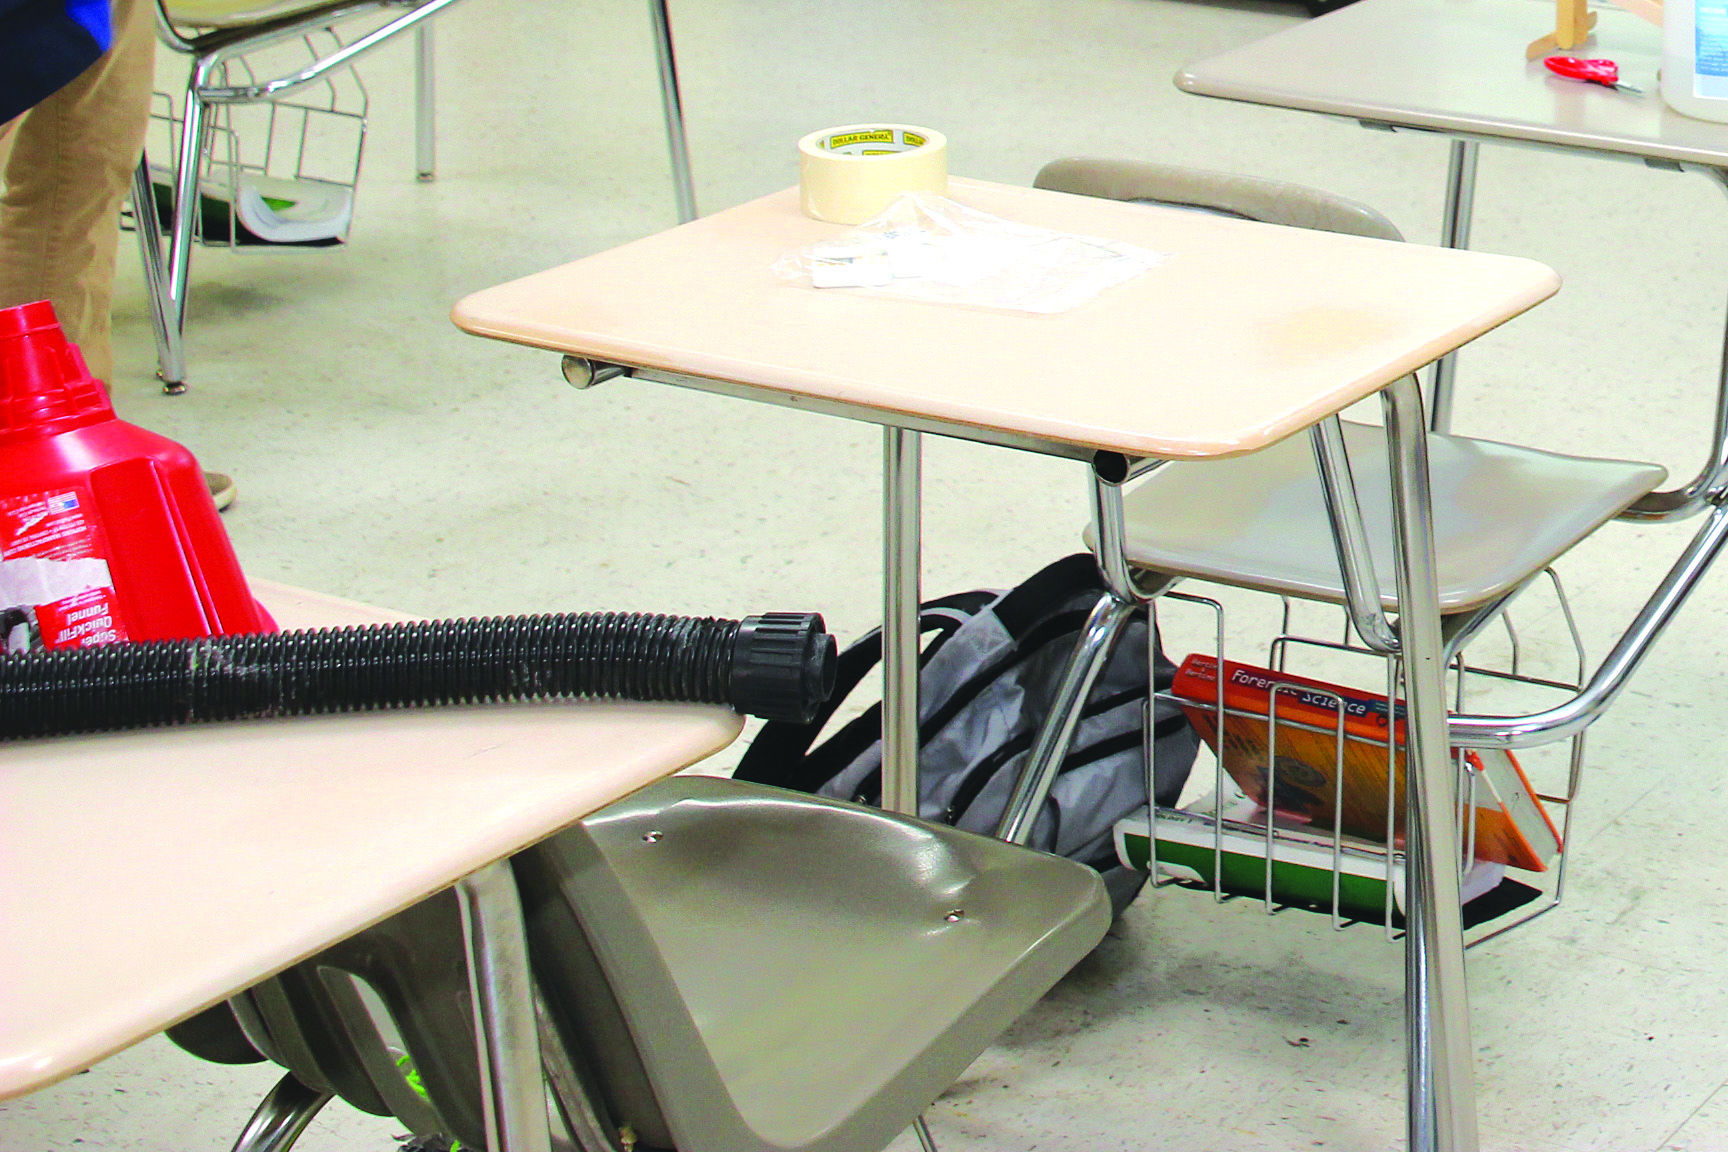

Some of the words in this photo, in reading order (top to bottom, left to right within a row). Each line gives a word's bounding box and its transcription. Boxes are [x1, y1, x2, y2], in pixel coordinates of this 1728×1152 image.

[831, 134, 859, 146] DOLLAR
[66, 601, 109, 625] Funnel
[58, 615, 113, 644] QuickFill
